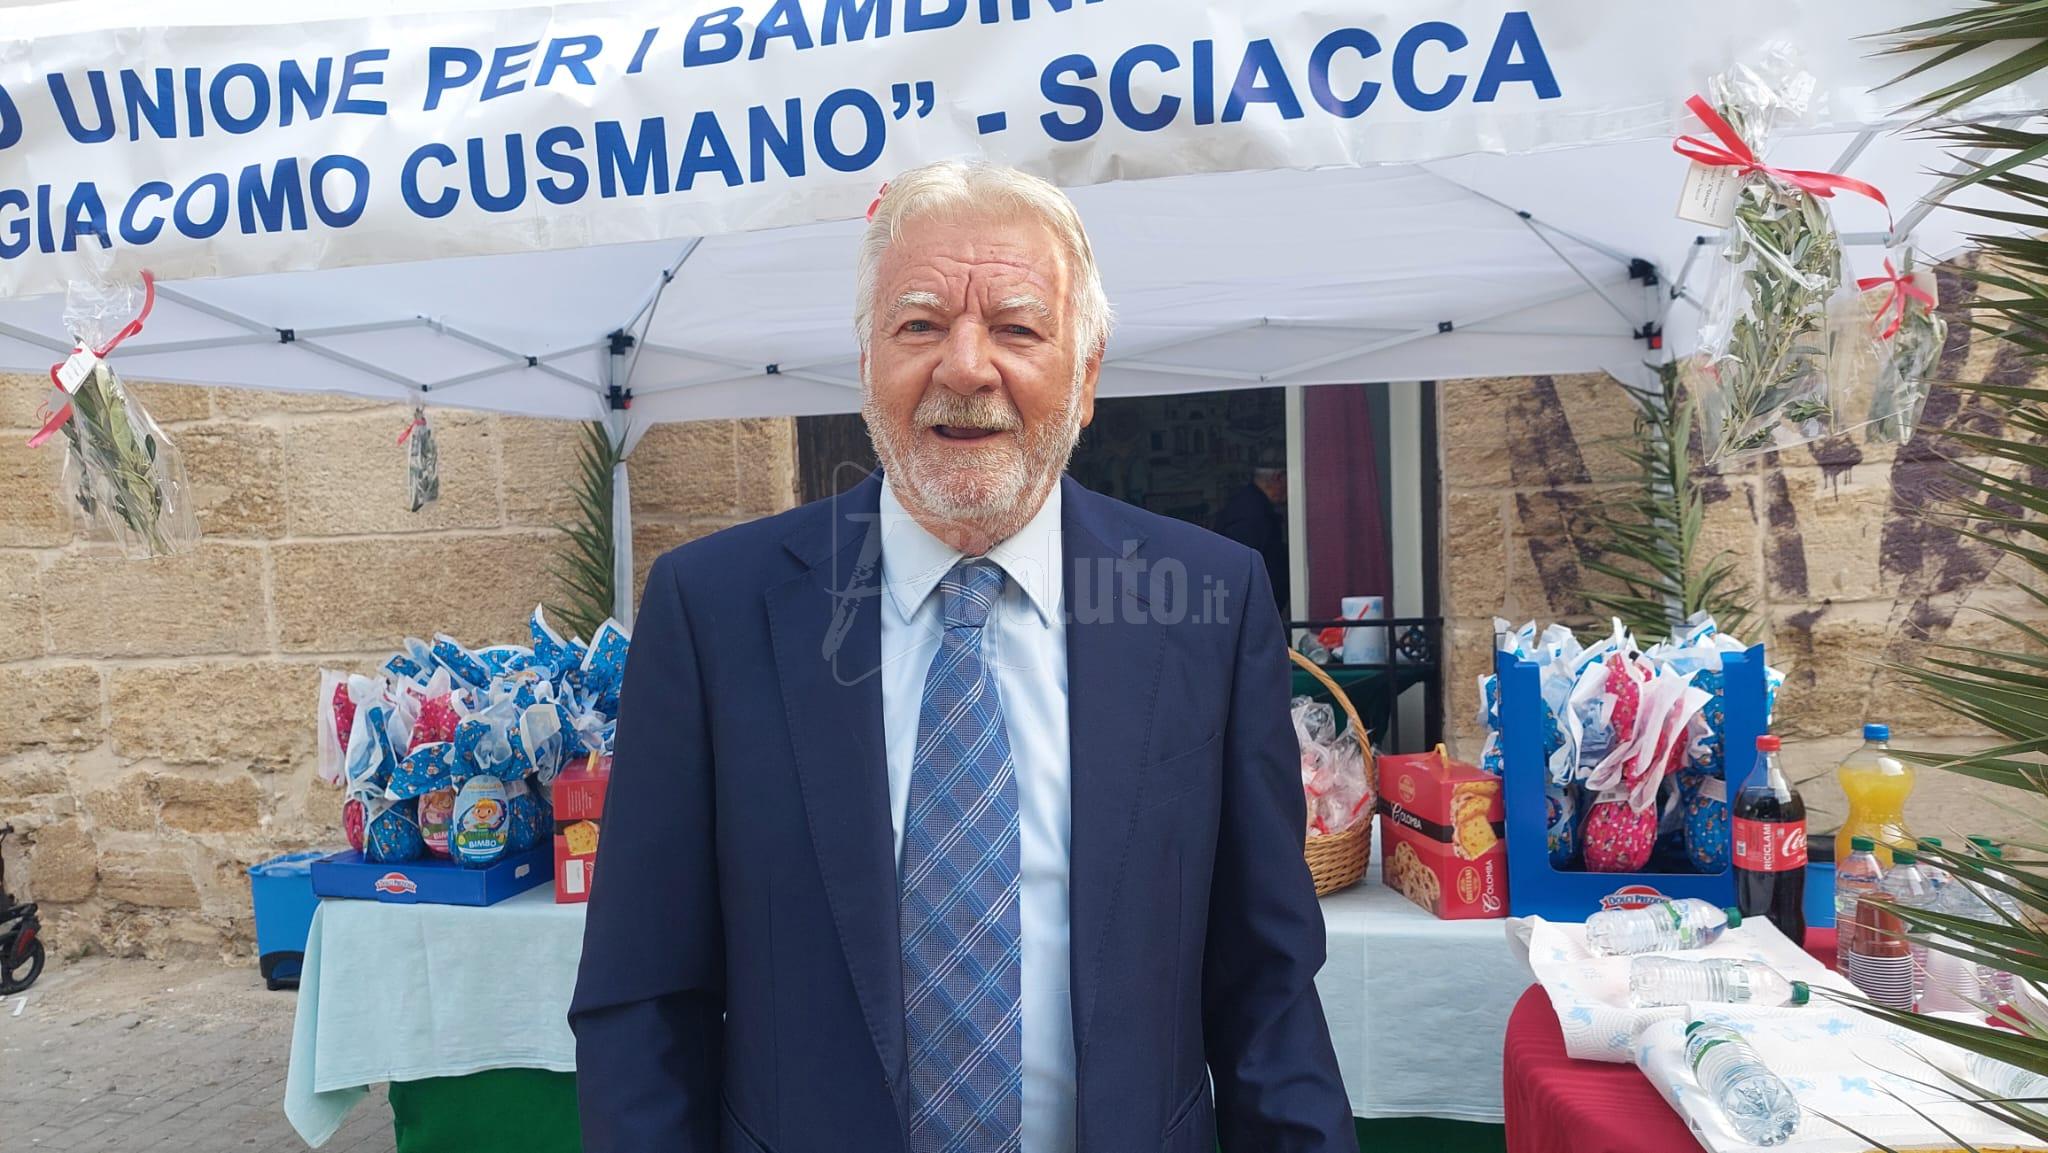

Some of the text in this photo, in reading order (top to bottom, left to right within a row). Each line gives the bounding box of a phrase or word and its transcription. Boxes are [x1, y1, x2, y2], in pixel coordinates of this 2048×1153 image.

[48, 48, 390, 144] UNIONE
[423, 34, 604, 112] PER
[0, 155, 370, 260] GIACOMO
[976, 111, 1008, 135] -
[1040, 11, 1563, 142] SCIACCA
[468, 839, 497, 849] BIMBO
[1763, 824, 1772, 869] RICICLAMI
[1482, 860, 1501, 913] COLOMBA
